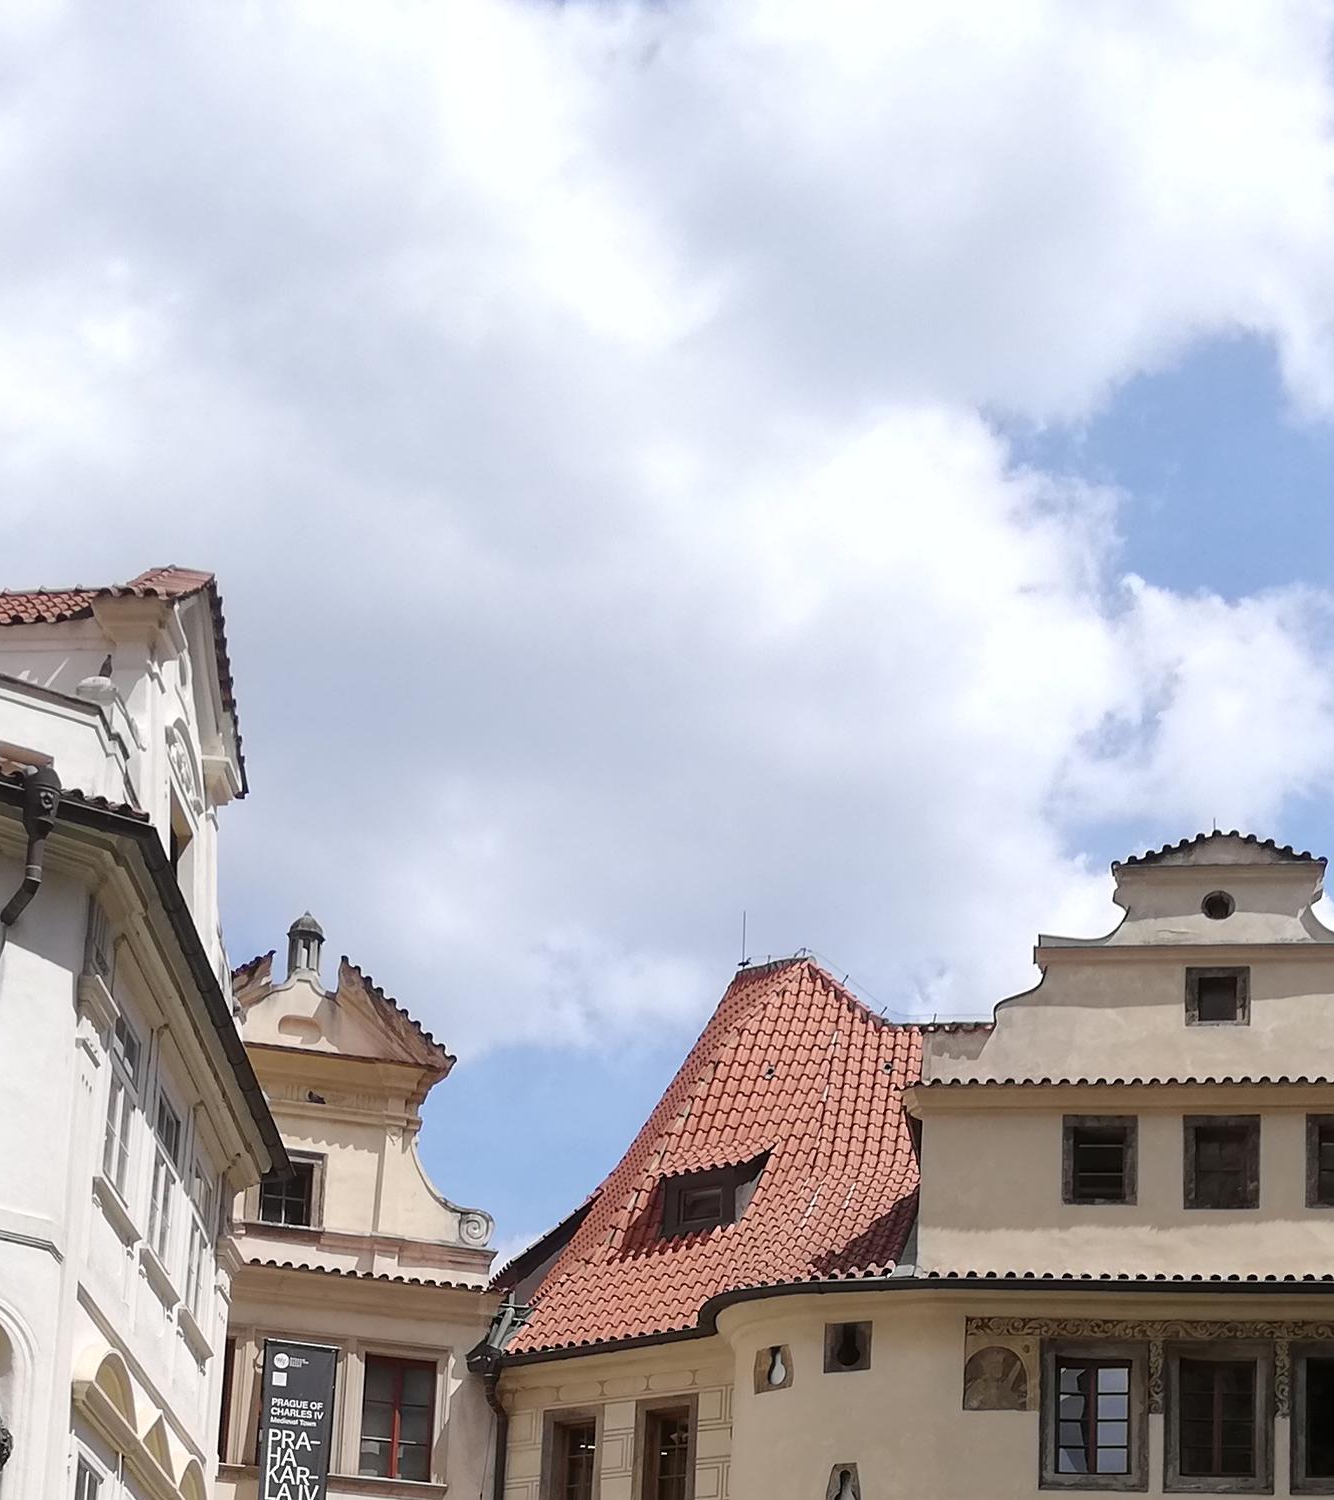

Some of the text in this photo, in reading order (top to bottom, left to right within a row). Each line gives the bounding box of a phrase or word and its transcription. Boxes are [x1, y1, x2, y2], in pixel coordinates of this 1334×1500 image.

[271, 1398, 323, 1410] PRAGUE OF
[270, 1407, 324, 1420] CHARLES IV
